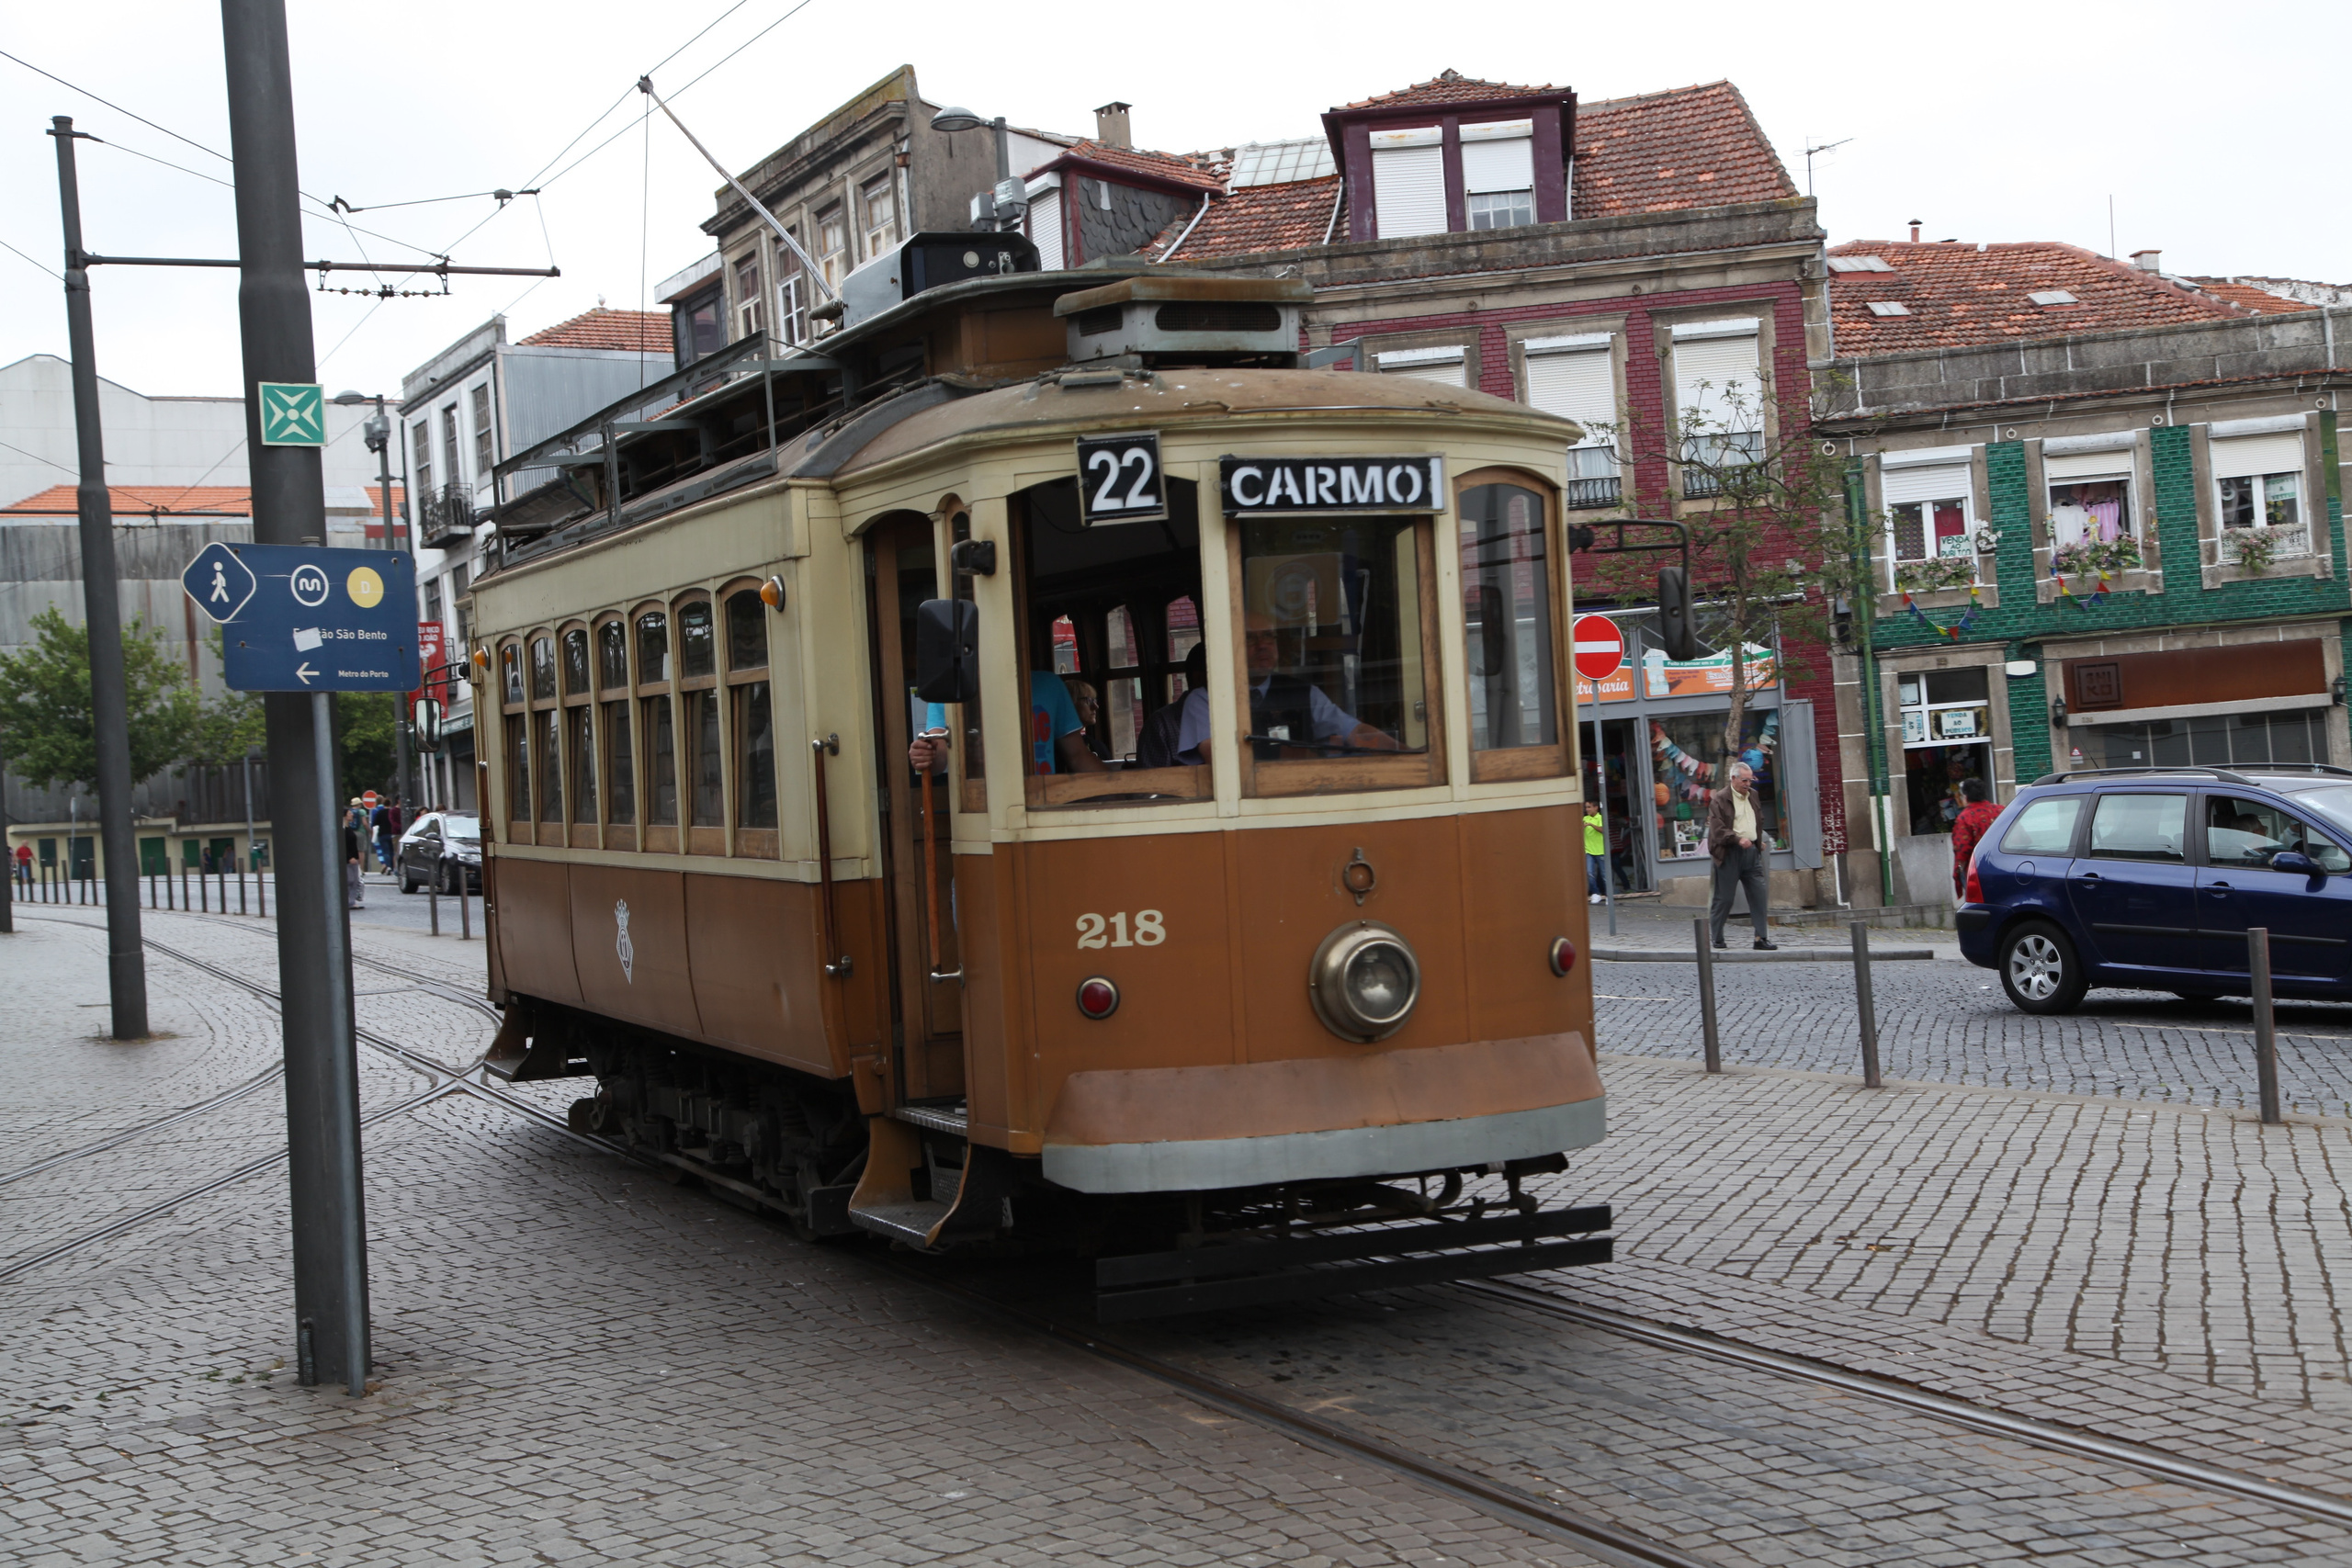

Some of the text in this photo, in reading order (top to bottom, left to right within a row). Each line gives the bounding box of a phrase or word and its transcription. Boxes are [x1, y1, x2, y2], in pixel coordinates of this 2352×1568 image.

[1088, 447, 1157, 512] 22
[1229, 464, 1423, 506] CARMO
[1941, 536, 1971, 544] VENDA
[360, 581, 370, 593] D
[336, 629, 356, 639] São
[357, 629, 388, 640] Bento
[338, 670, 359, 678] Metro
[369, 670, 390, 678] Porto
[1075, 908, 1167, 950] 218
